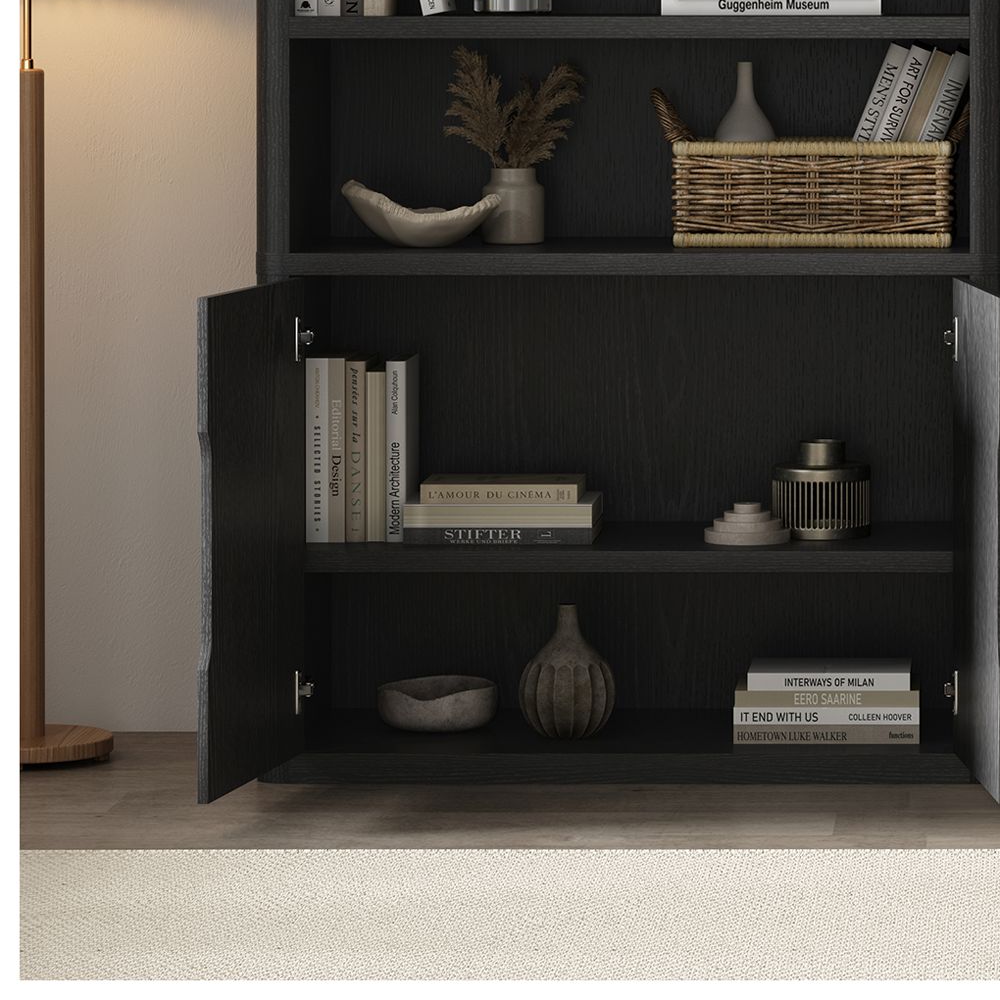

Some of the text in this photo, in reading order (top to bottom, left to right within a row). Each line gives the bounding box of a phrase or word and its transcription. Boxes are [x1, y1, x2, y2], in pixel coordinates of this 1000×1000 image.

[718, 0, 830, 12] Guggenheim Museum
[872, 63, 898, 107] MEN'S
[895, 57, 922, 105] ART FOR
[350, 368, 360, 405] pensées
[352, 432, 361, 444] la
[329, 399, 342, 497] Editorial Design
[313, 425, 321, 522] SELECTED STORIES
[351, 450, 361, 521] DANSE
[389, 442, 400, 535] Modern Architecture
[428, 489, 552, 499] L'AMOUR DU CINÉMA
[444, 529, 521, 540] STIFTER
[784, 678, 875, 687] INTERWAYS OF MILAN
[794, 693, 862, 706] EERO SAARINE
[740, 712, 819, 722] IT END WITH US
[848, 713, 912, 721] COLLEEN HOOVER
[737, 731, 848, 741] HOMETOWN LUKE WALKER
[888, 731, 914, 739] functions
